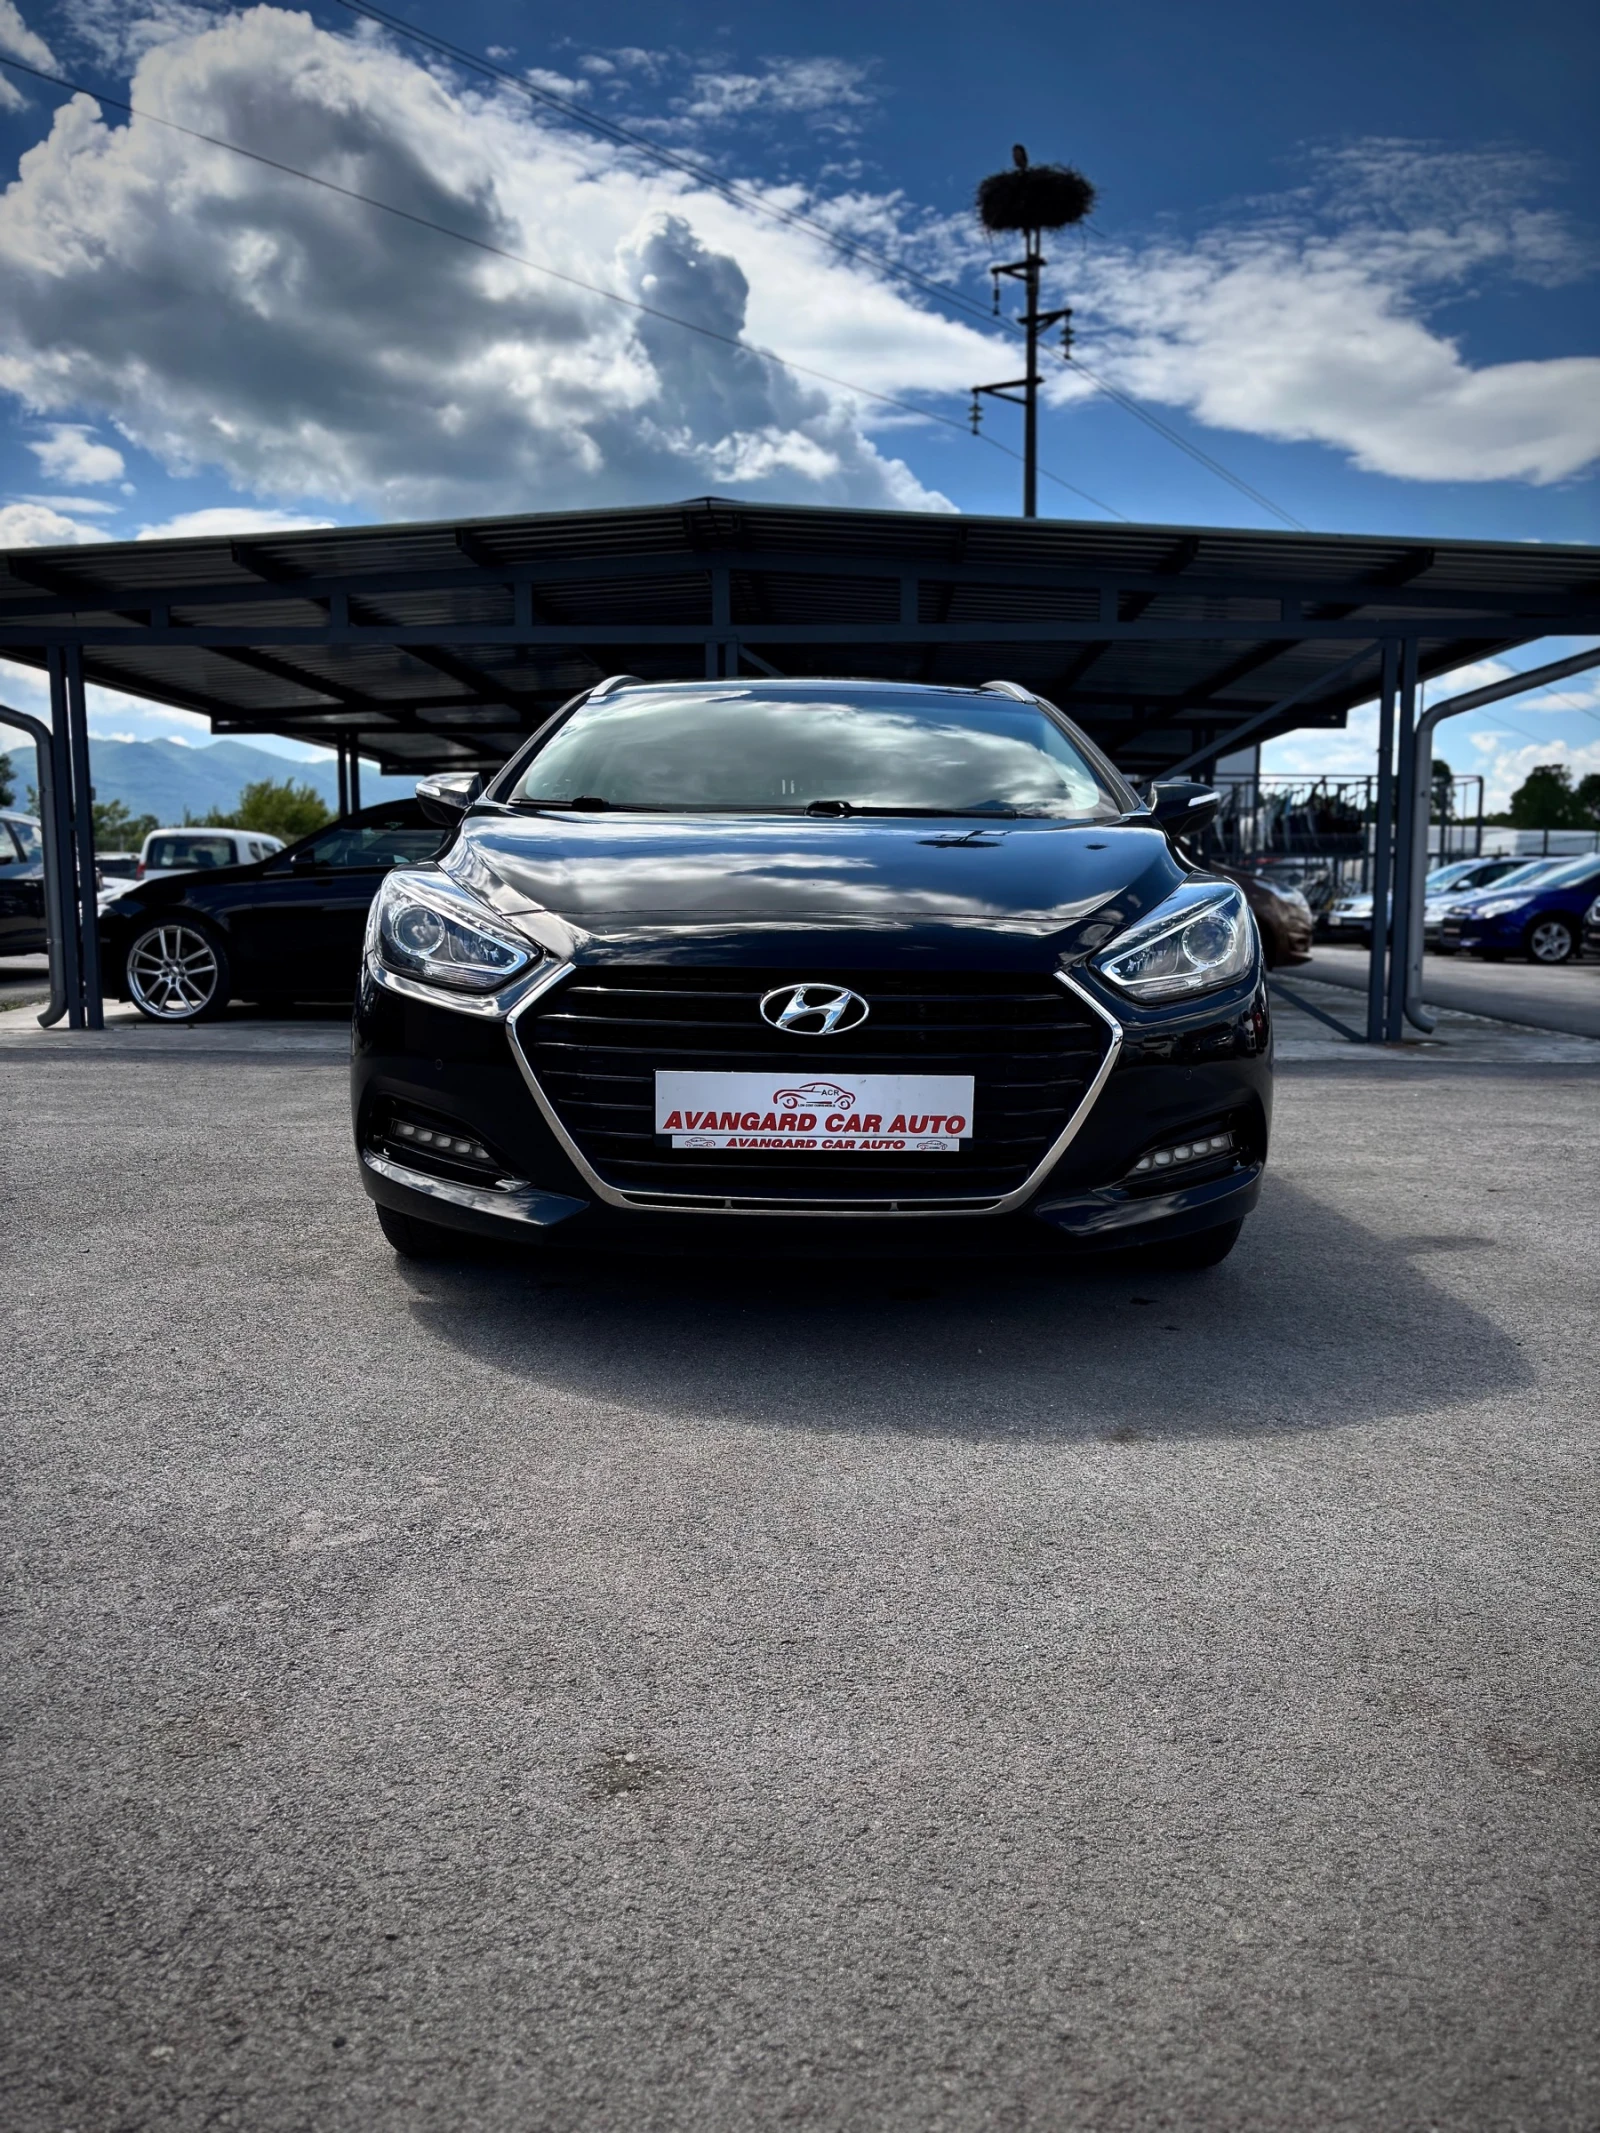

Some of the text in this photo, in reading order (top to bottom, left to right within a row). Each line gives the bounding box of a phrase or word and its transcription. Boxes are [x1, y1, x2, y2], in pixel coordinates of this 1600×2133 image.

[663, 1111, 966, 1135] AVANGARD CAR AUTO
[726, 1137, 906, 1150] AVANGARD CAR AUTO
